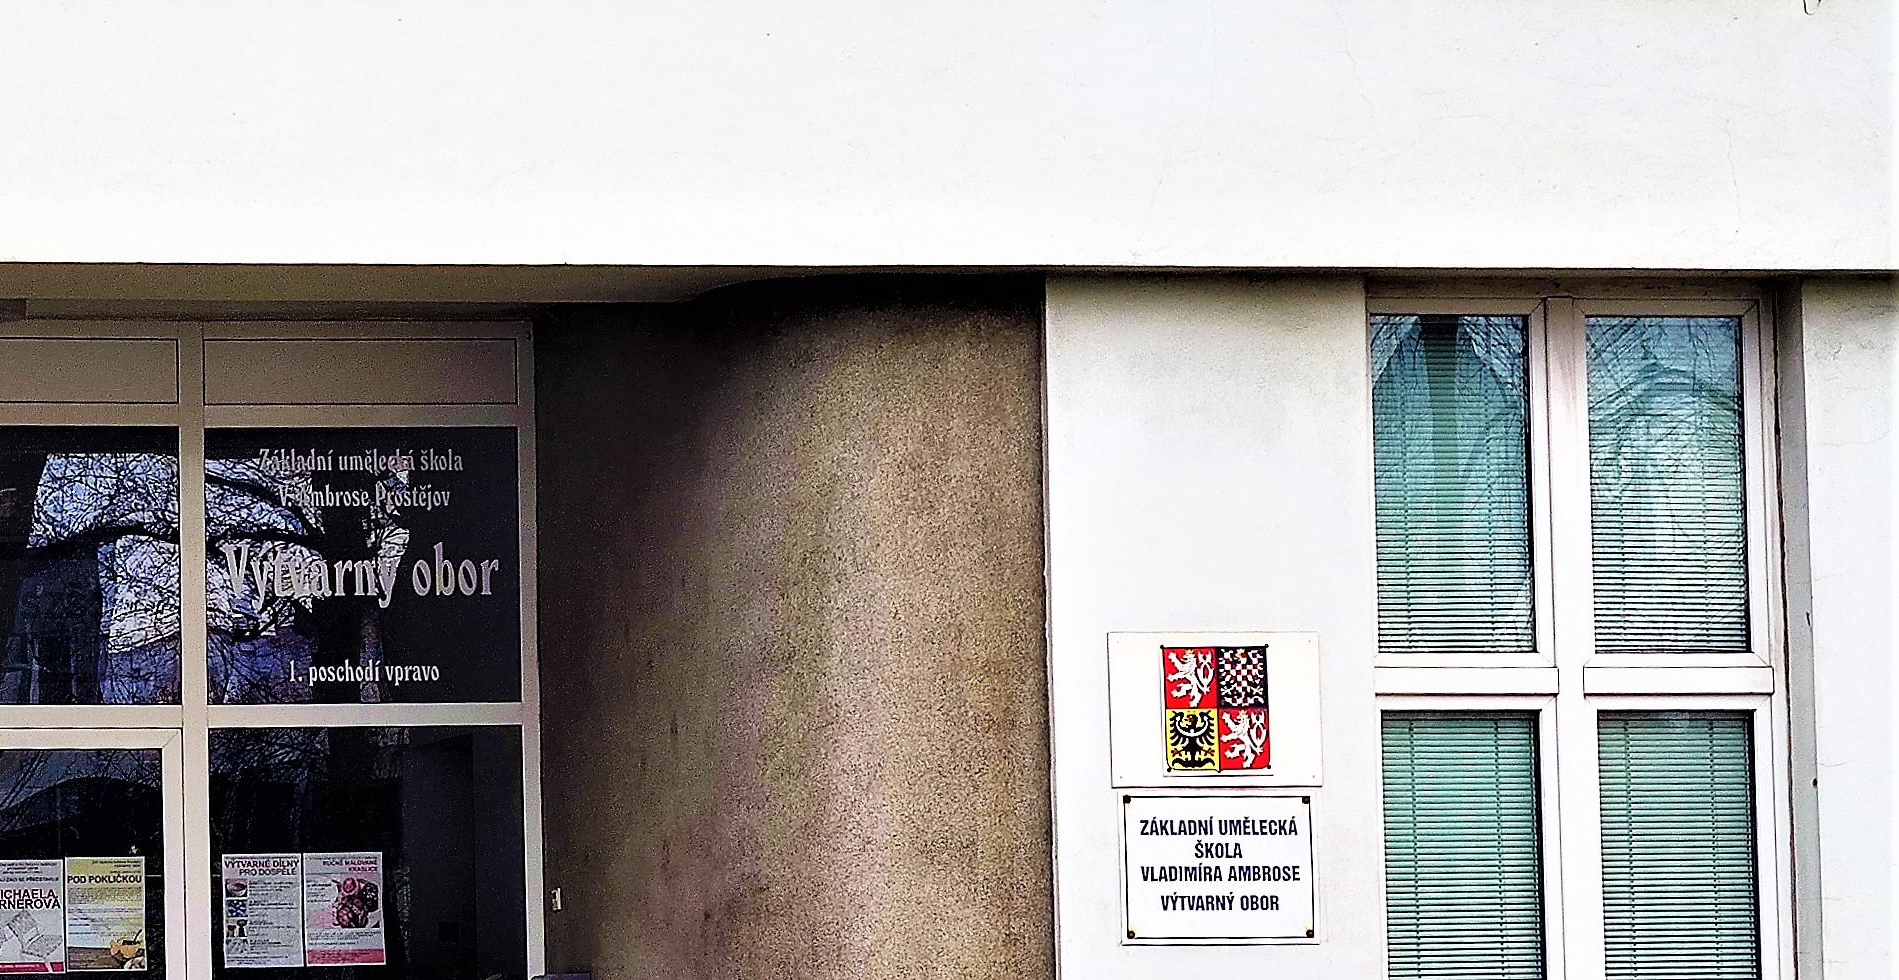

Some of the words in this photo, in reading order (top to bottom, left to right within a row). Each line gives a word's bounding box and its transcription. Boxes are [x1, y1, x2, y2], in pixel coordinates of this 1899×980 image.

[259, 448, 333, 472] Základní
[339, 448, 414, 472] umělecká
[421, 448, 464, 472] škola
[279, 484, 293, 507] V.
[375, 482, 451, 511] Prostějov
[412, 541, 500, 597] obor
[289, 661, 303, 682] 1.
[309, 659, 381, 686] poschodí
[384, 664, 440, 686] vpravo
[1139, 815, 1215, 836] ZÁKLADNÍ
[1219, 815, 1299, 836] UMĚLECKÁ
[1194, 839, 1244, 859] ŠKOLA
[67, 875, 87, 884] POD
[1140, 861, 1223, 882] VLADIMÍRA
[1228, 864, 1301, 882] AMBROSE
[1160, 891, 1235, 912] VÝTVARNÝ
[1240, 895, 1280, 912] OBOR
